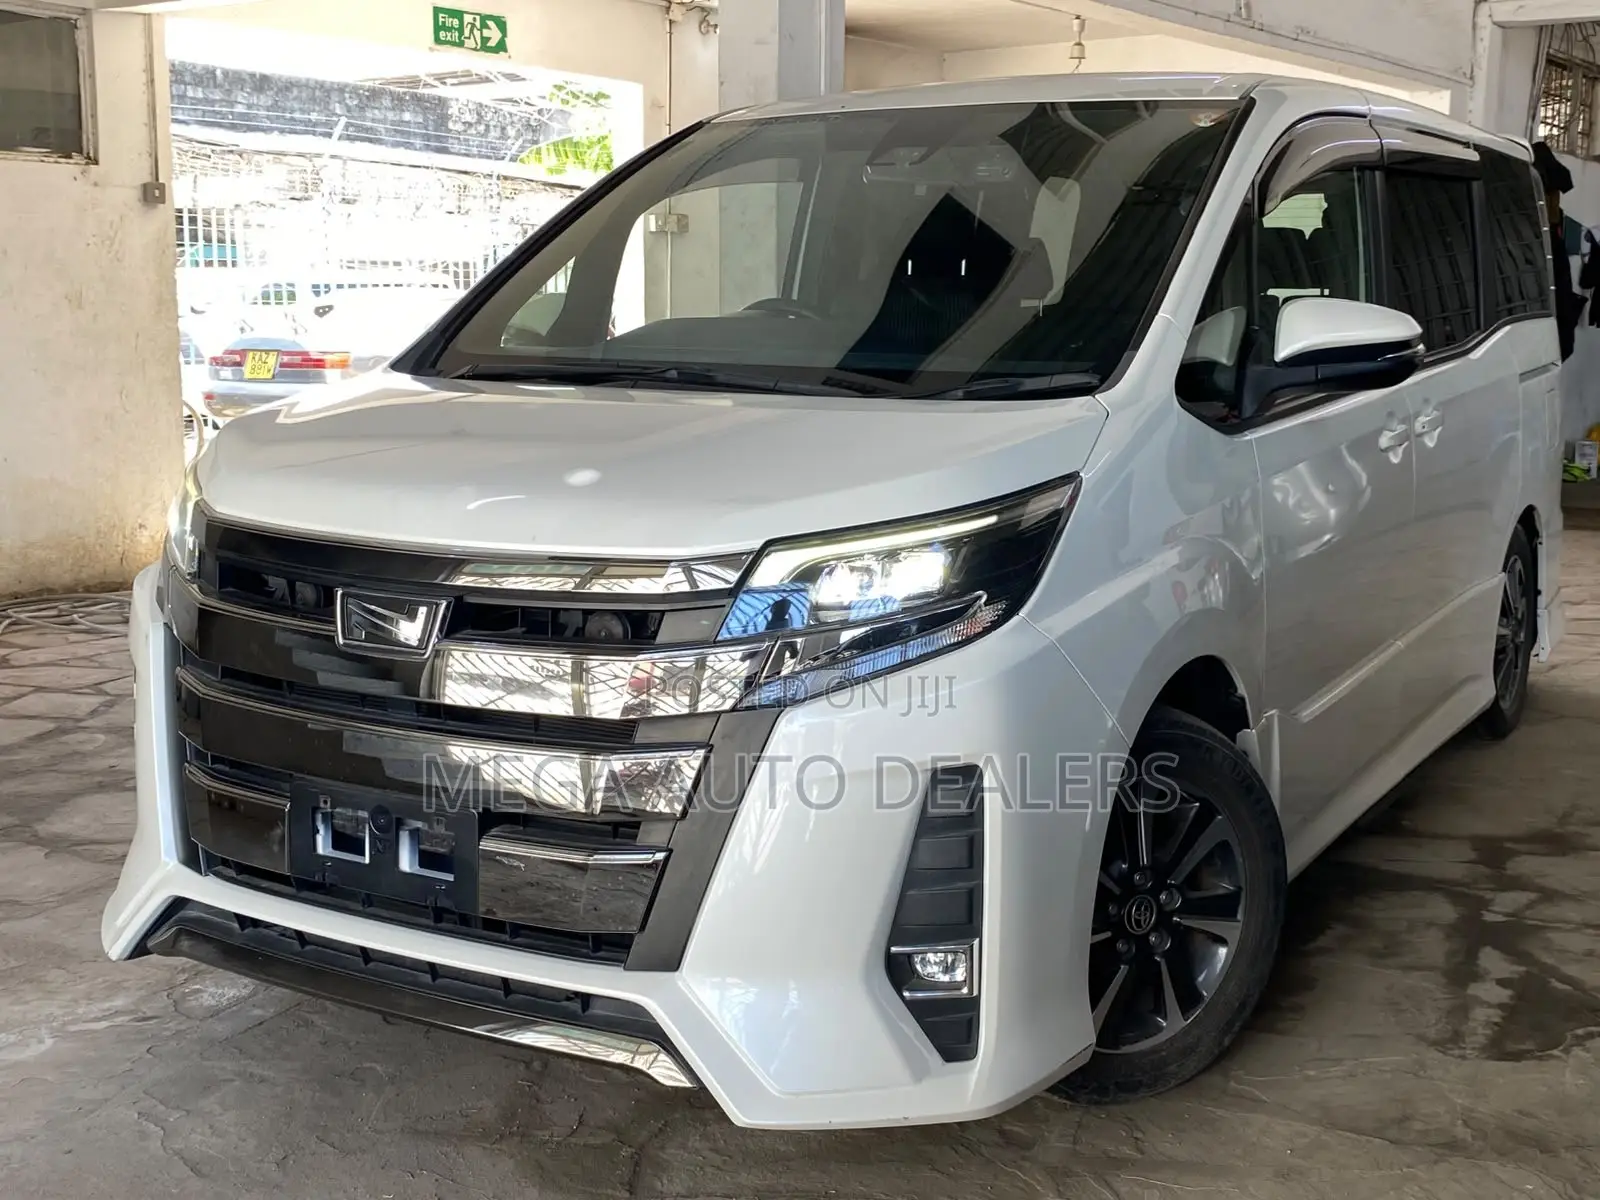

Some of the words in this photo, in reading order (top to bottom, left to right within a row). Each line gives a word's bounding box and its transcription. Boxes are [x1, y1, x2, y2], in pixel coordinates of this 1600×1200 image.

[438, 13, 459, 28] Fire
[439, 29, 459, 42] exit
[250, 351, 270, 364] KAZ
